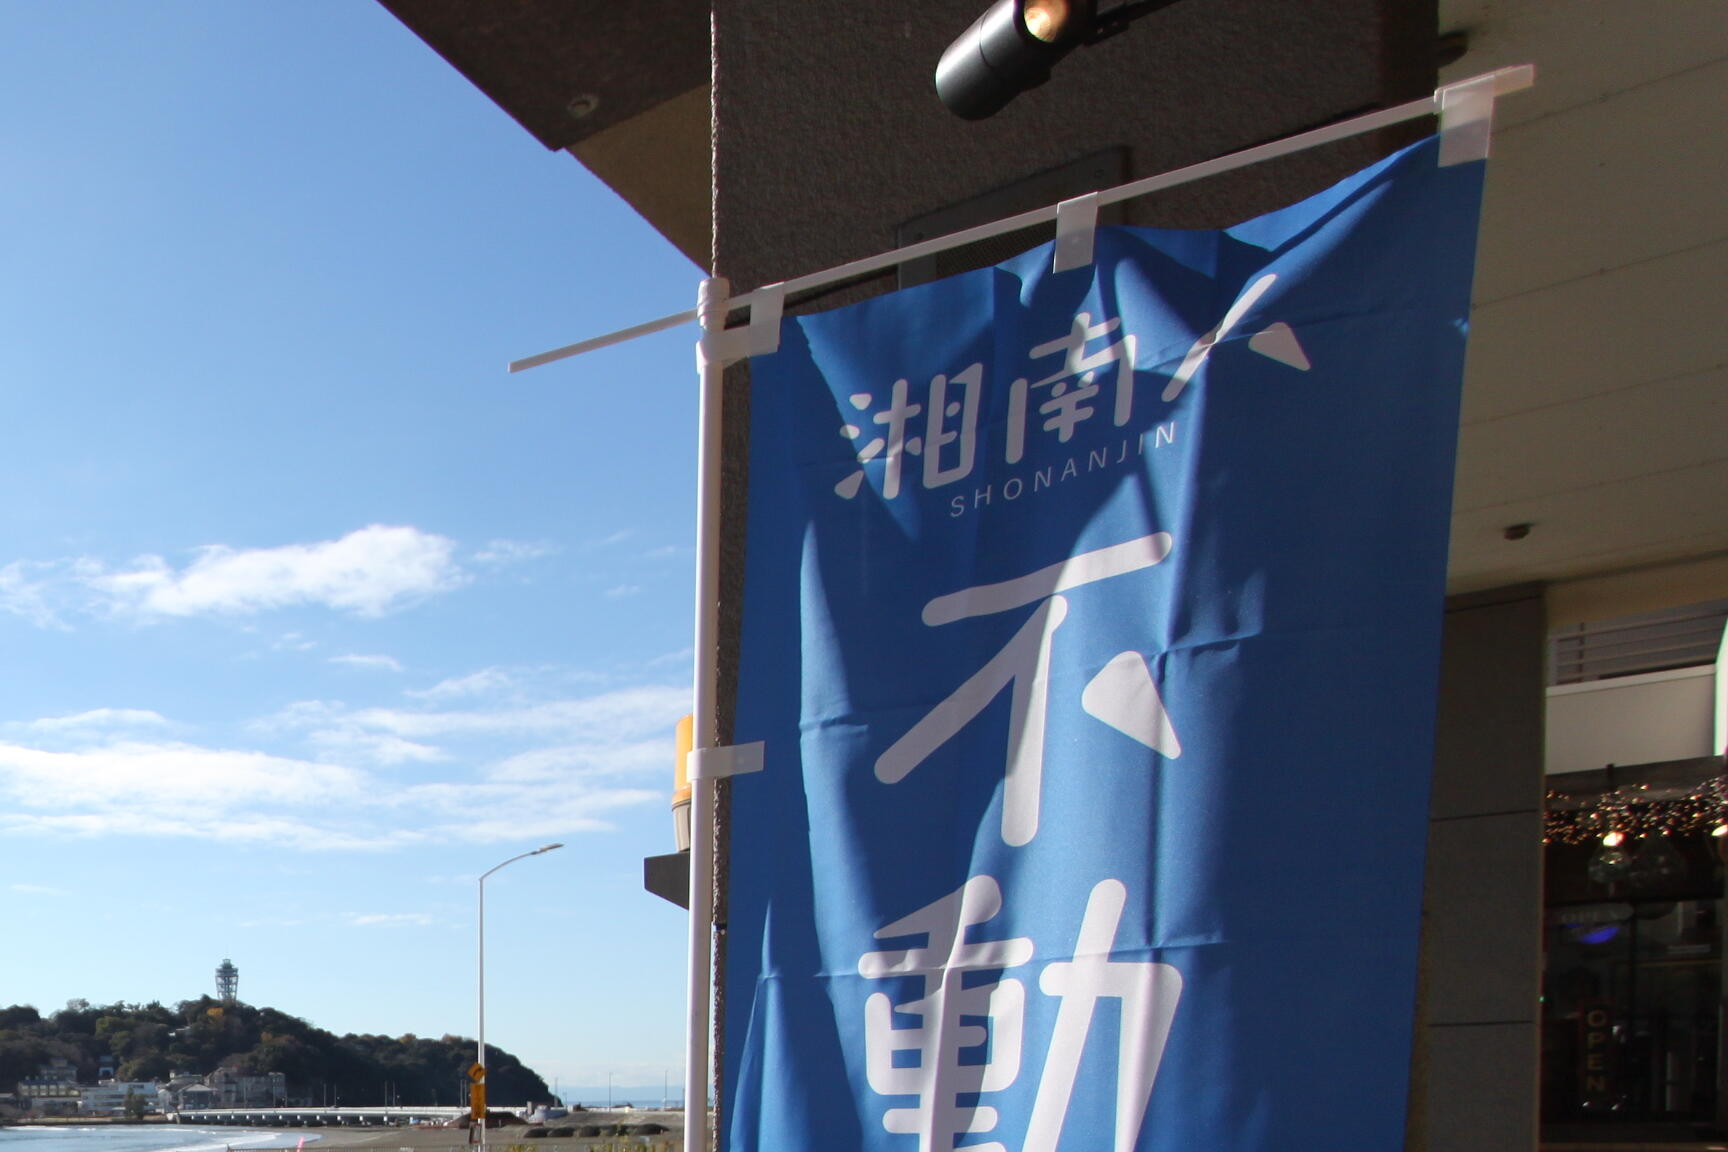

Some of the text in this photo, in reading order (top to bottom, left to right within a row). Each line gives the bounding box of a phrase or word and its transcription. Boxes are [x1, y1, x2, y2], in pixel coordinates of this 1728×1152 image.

[835, 273, 1312, 500] 湘南人
[949, 420, 1176, 518] SHONANJIN
[1585, 1009, 1607, 1092] OPEN
